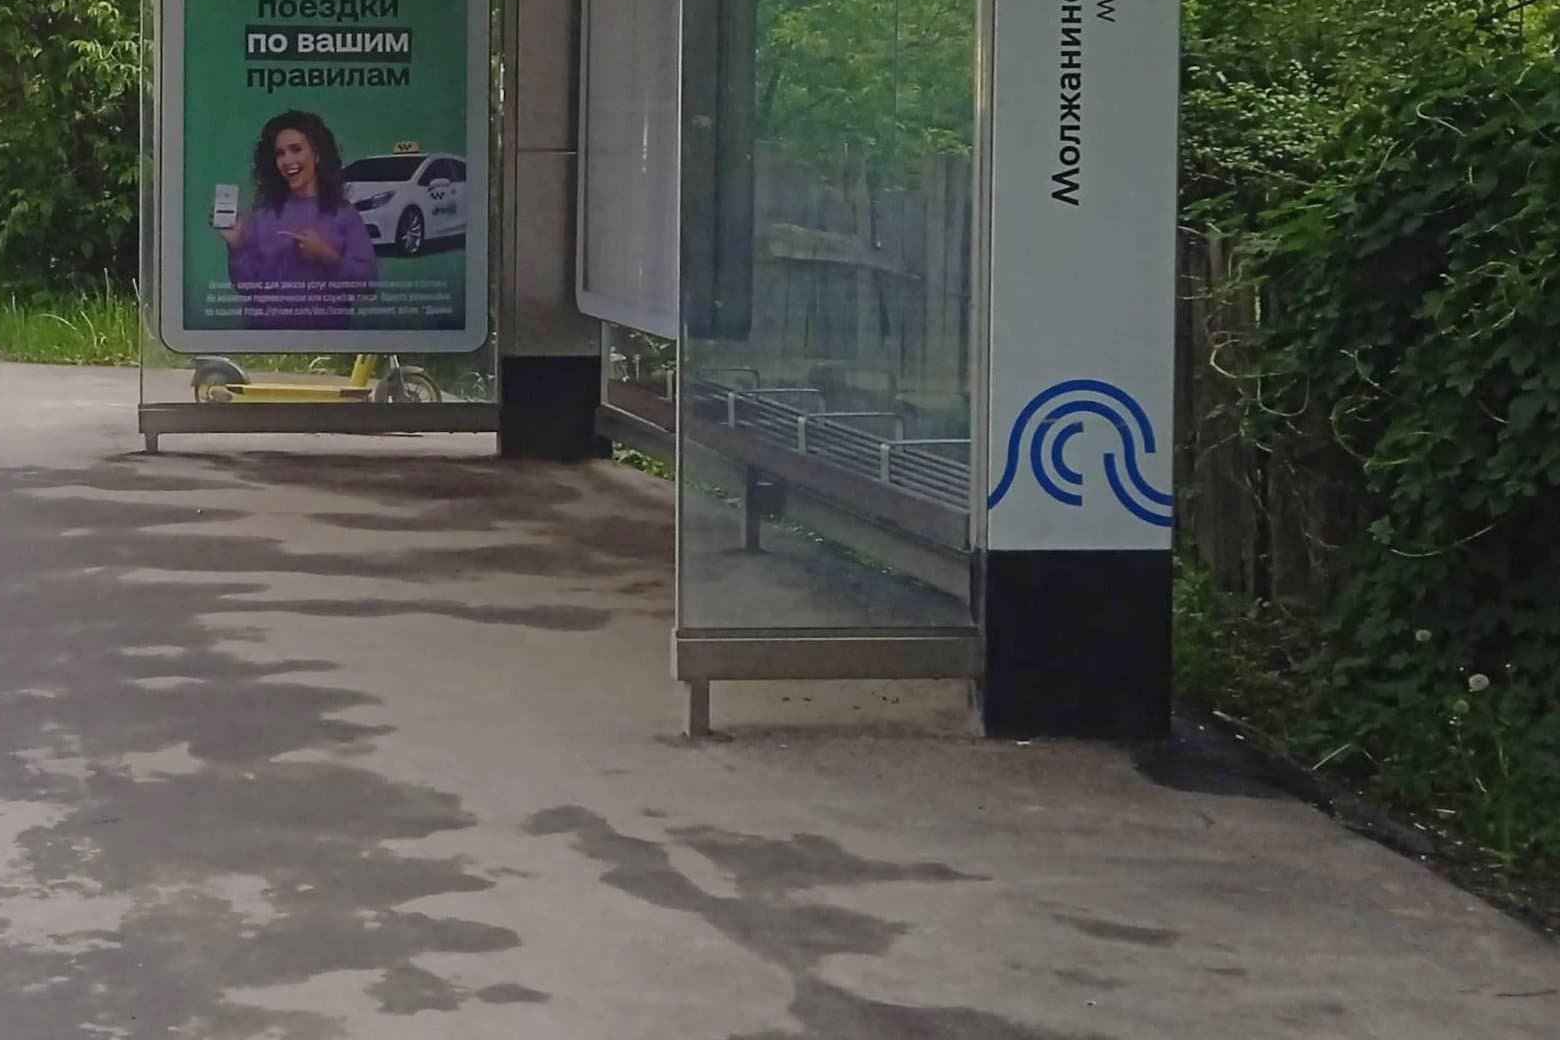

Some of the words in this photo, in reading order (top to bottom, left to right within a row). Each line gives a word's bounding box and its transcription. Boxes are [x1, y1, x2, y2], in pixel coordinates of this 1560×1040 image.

[247, 32, 288, 53] по
[297, 31, 409, 53] вашим
[246, 66, 411, 94] правилам
